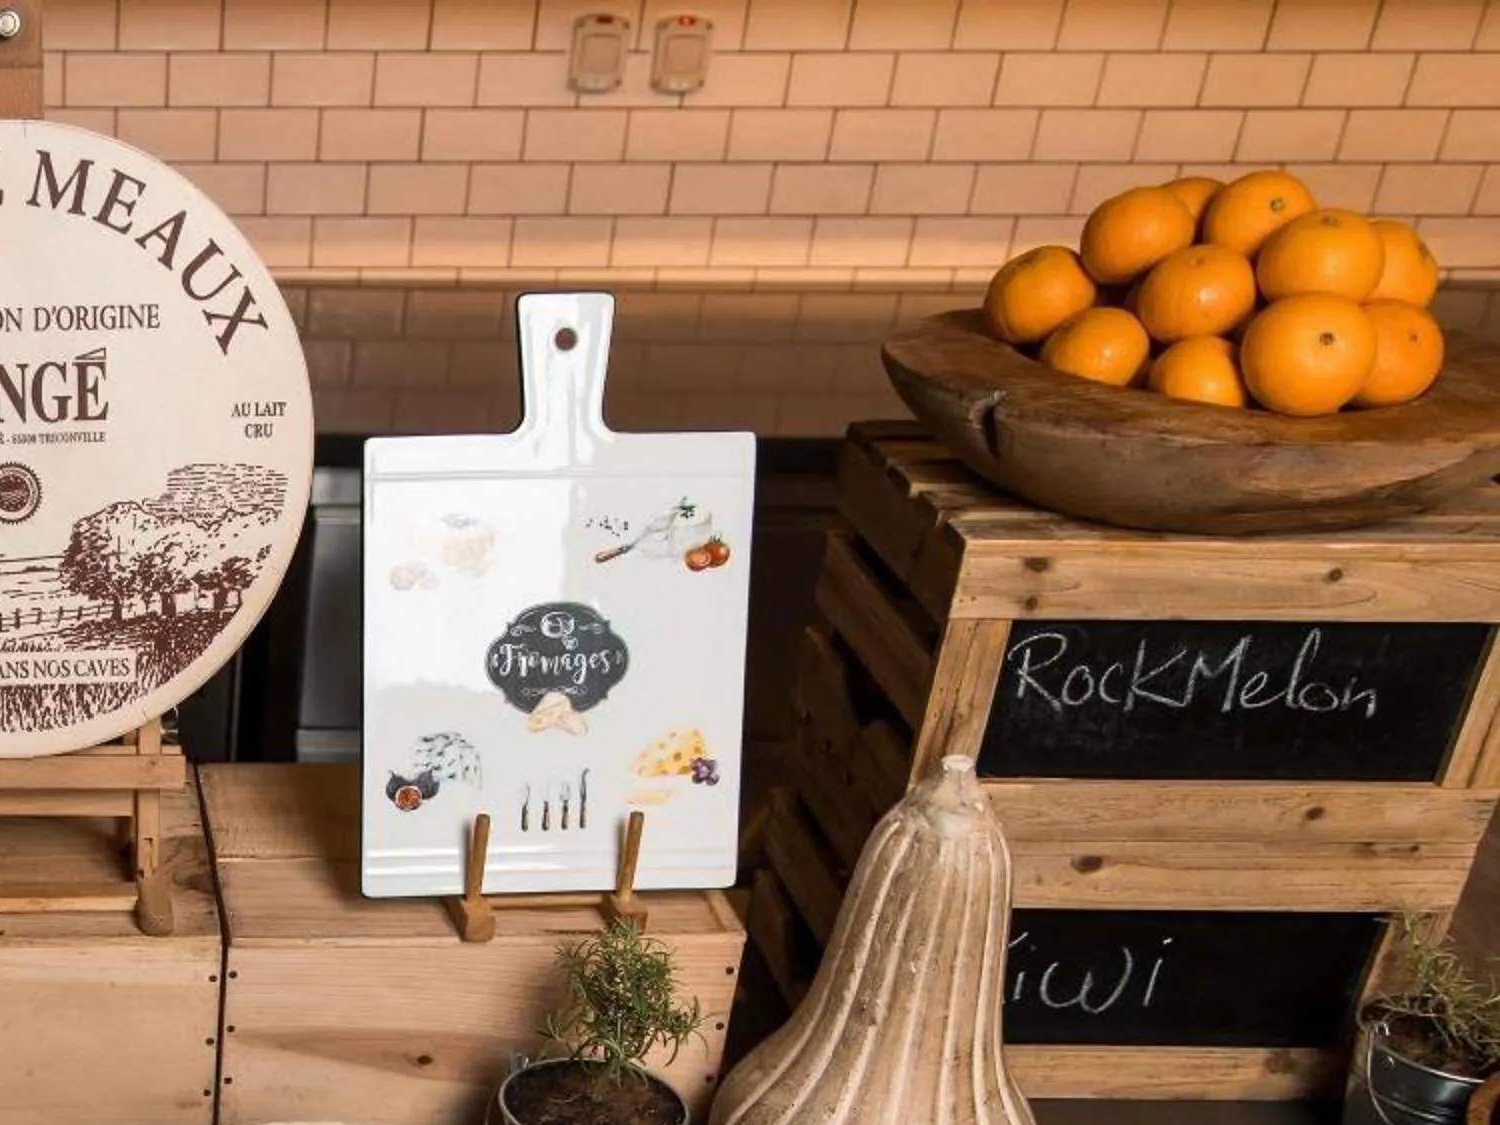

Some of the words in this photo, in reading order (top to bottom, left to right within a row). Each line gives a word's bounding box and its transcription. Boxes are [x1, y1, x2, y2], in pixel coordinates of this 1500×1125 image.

[25, 149, 268, 354] MEAUX
[33, 303, 161, 332] D'ORIGINE
[231, 402, 251, 417] AU
[254, 401, 287, 417] LAIT
[244, 423, 273, 439] CRU
[32, 659, 71, 679] NOS
[73, 657, 130, 678] CAVES
[499, 643, 611, 685] Fromages
[1008, 931, 1173, 1015] iwi
